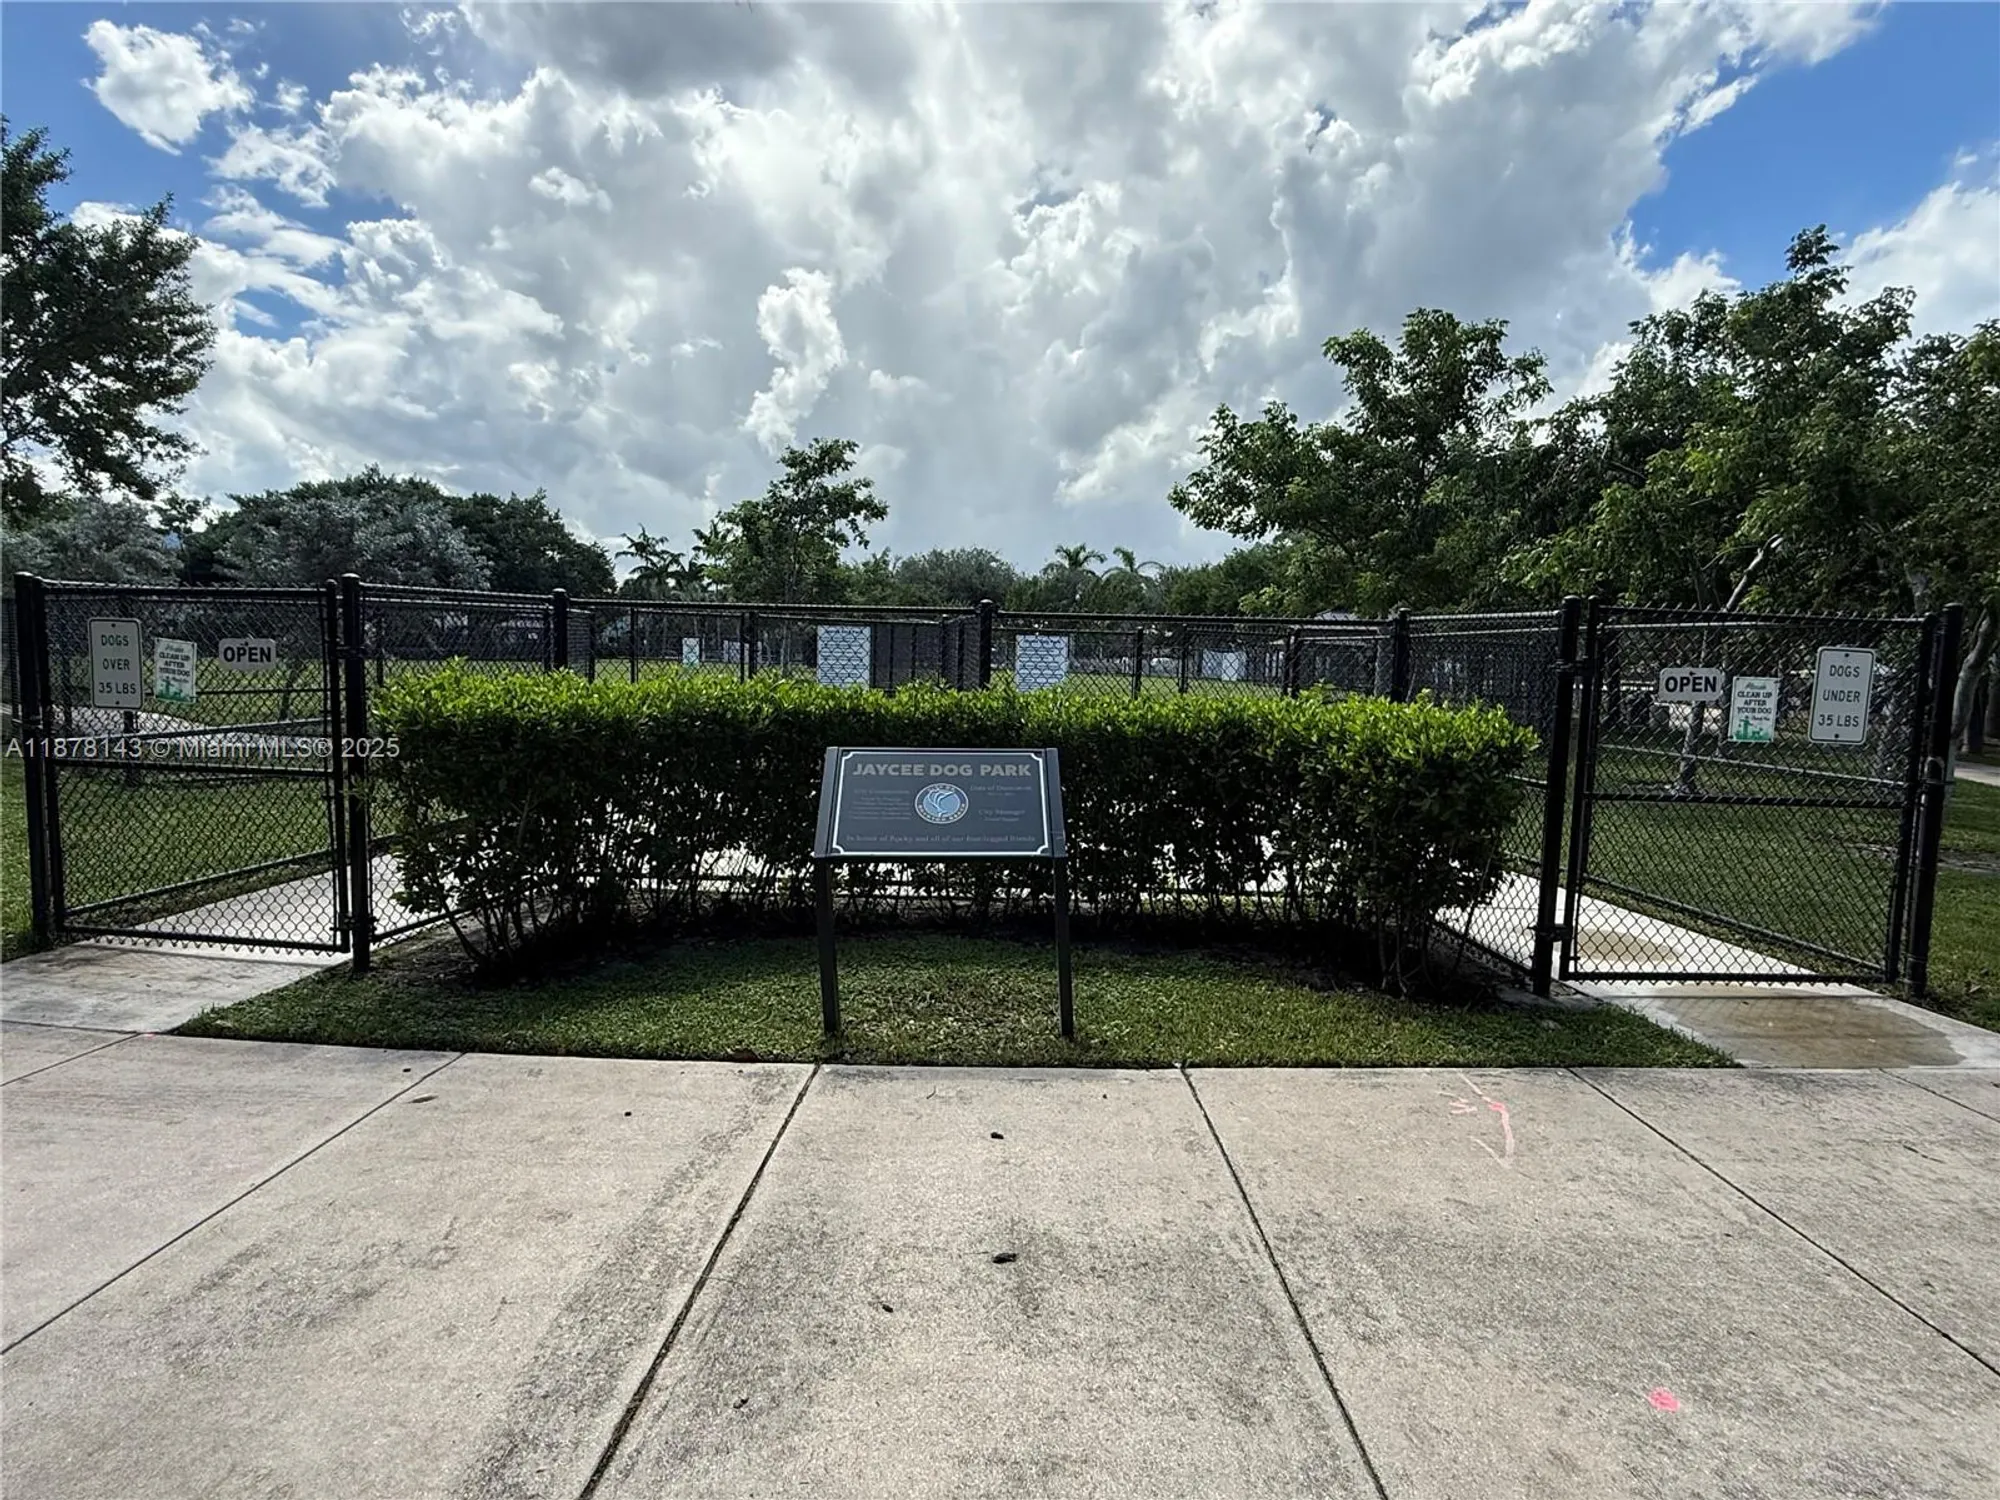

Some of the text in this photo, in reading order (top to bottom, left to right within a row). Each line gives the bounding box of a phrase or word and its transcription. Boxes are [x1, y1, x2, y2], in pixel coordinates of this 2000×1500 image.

[101, 634, 129, 647] DOGS
[159, 652, 180, 661] CLEAN
[223, 645, 272, 663] OPEN
[103, 659, 130, 671] OVER
[1829, 664, 1860, 677] DOGS
[99, 682, 136, 695] 35 LBS
[1665, 676, 1717, 693] OPEN
[1823, 690, 1861, 703] UNDER
[1818, 714, 1859, 727] 35 LBS
[852, 763, 1031, 776] JAYCEE DOG PARK
